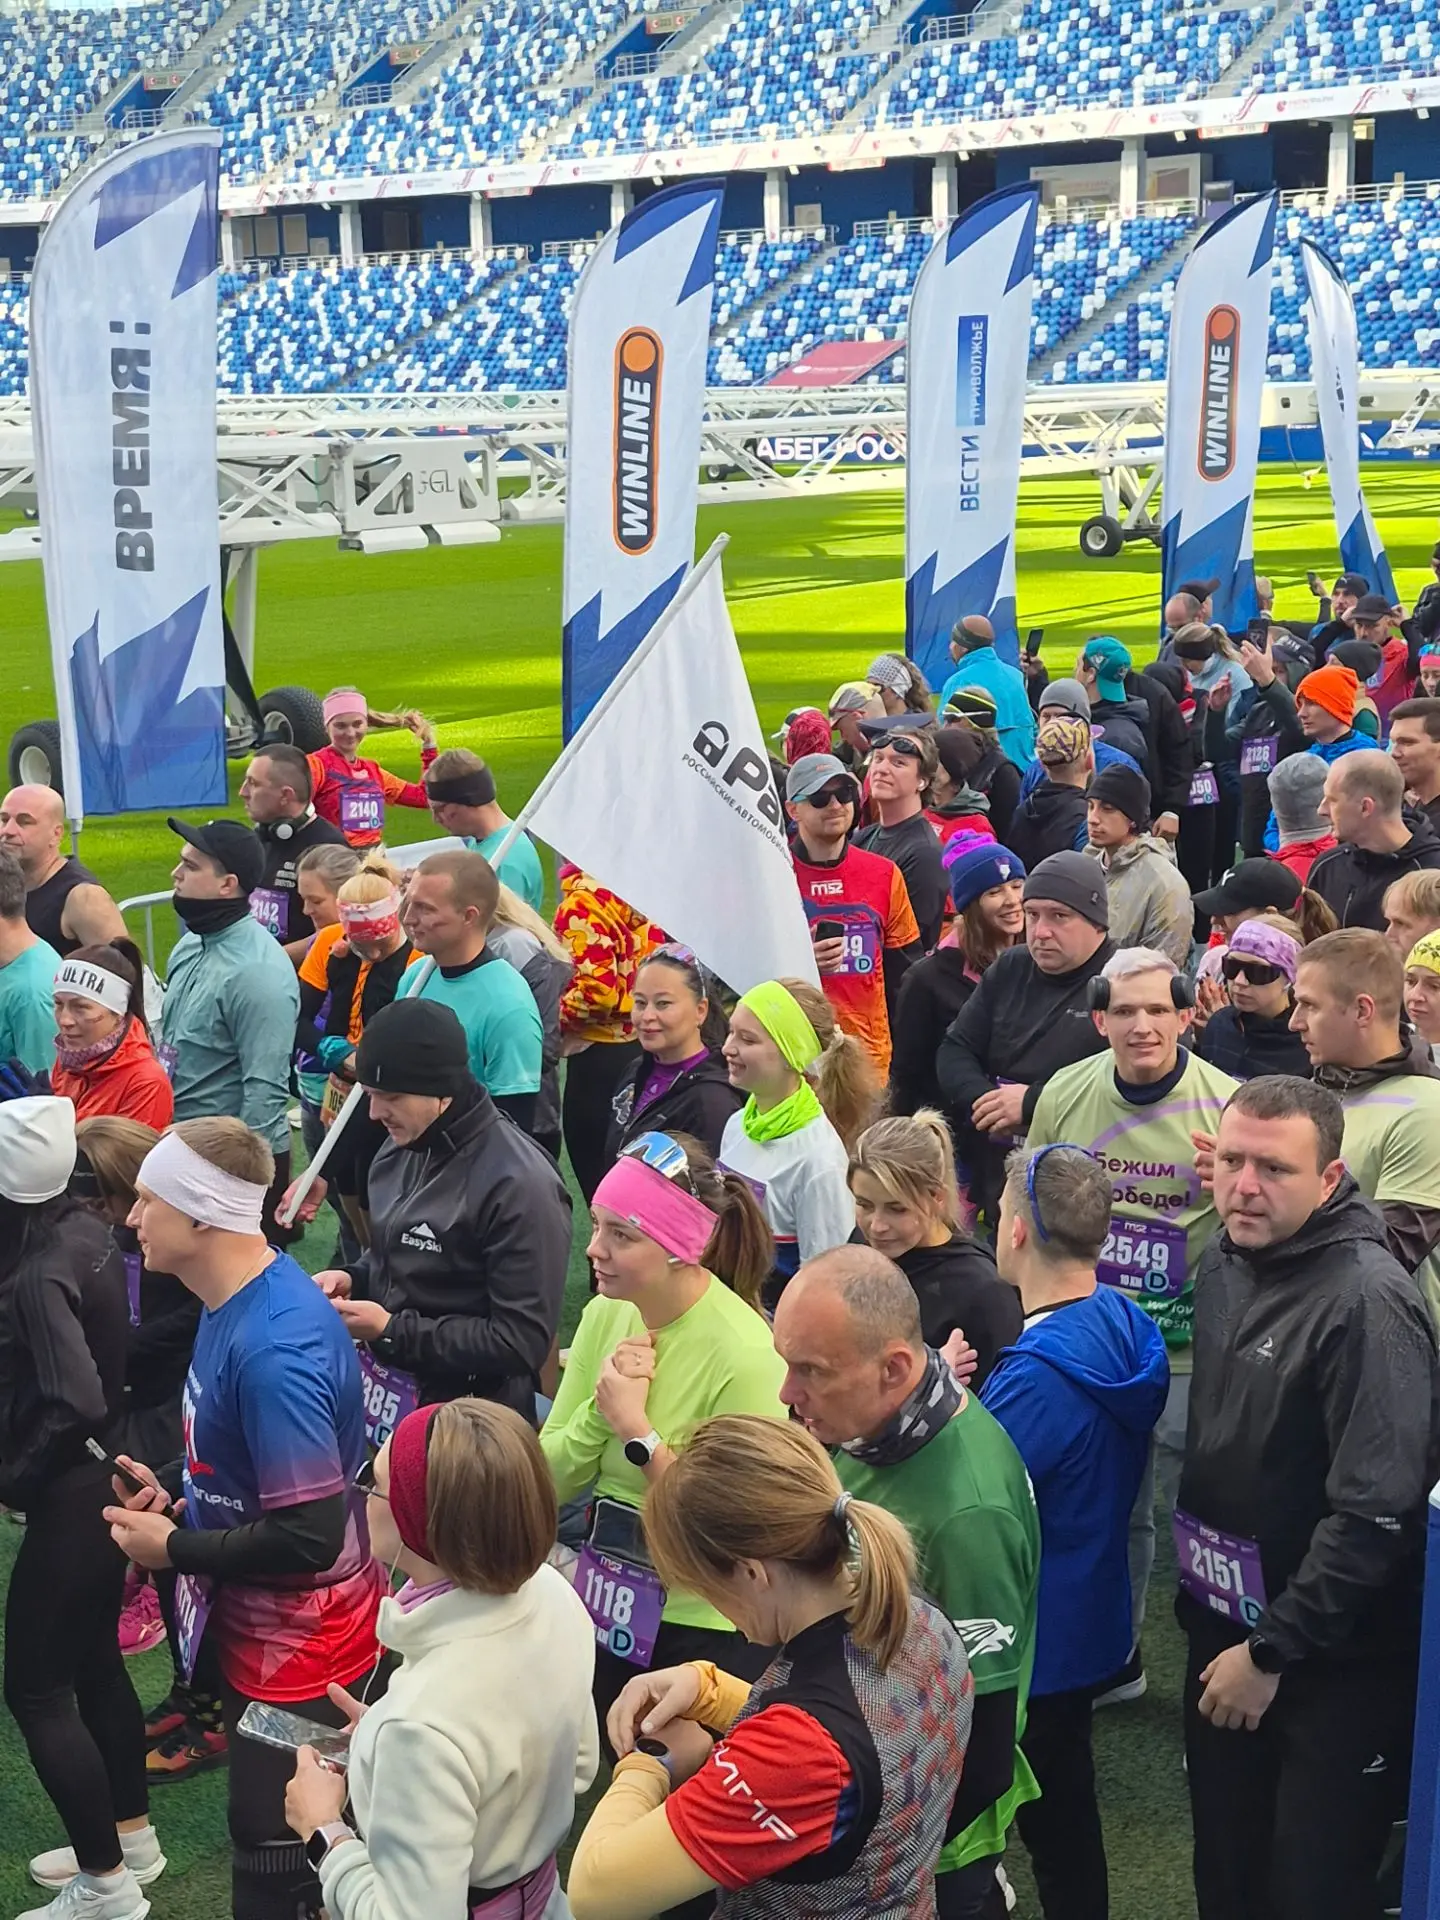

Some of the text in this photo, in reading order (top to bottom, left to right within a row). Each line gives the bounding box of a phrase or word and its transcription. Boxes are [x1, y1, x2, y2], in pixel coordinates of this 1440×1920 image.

[960, 320, 985, 512] ВЕСТИ ПРИВОЛЖЬЕ
[1205, 344, 1231, 468] WINLINE
[622, 377, 651, 537] WINLINE
[757, 437, 829, 461] АБЕГ
[681, 752, 737, 808] РОССИЙСКИЕ
[350, 801, 378, 818] 2140
[859, 958, 871, 971] D
[62, 965, 105, 995] ULTRA
[1094, 1150, 1176, 1179] Бежим
[1111, 1185, 1191, 1211] обеде!
[401, 1232, 443, 1254] EasySki
[1100, 1232, 1170, 1272] 2549
[1149, 1271, 1167, 1289] D
[1171, 1303, 1195, 1315] lov
[1188, 1538, 1245, 1597] 2151
[585, 1567, 636, 1626] 1118
[612, 1627, 632, 1652] D
